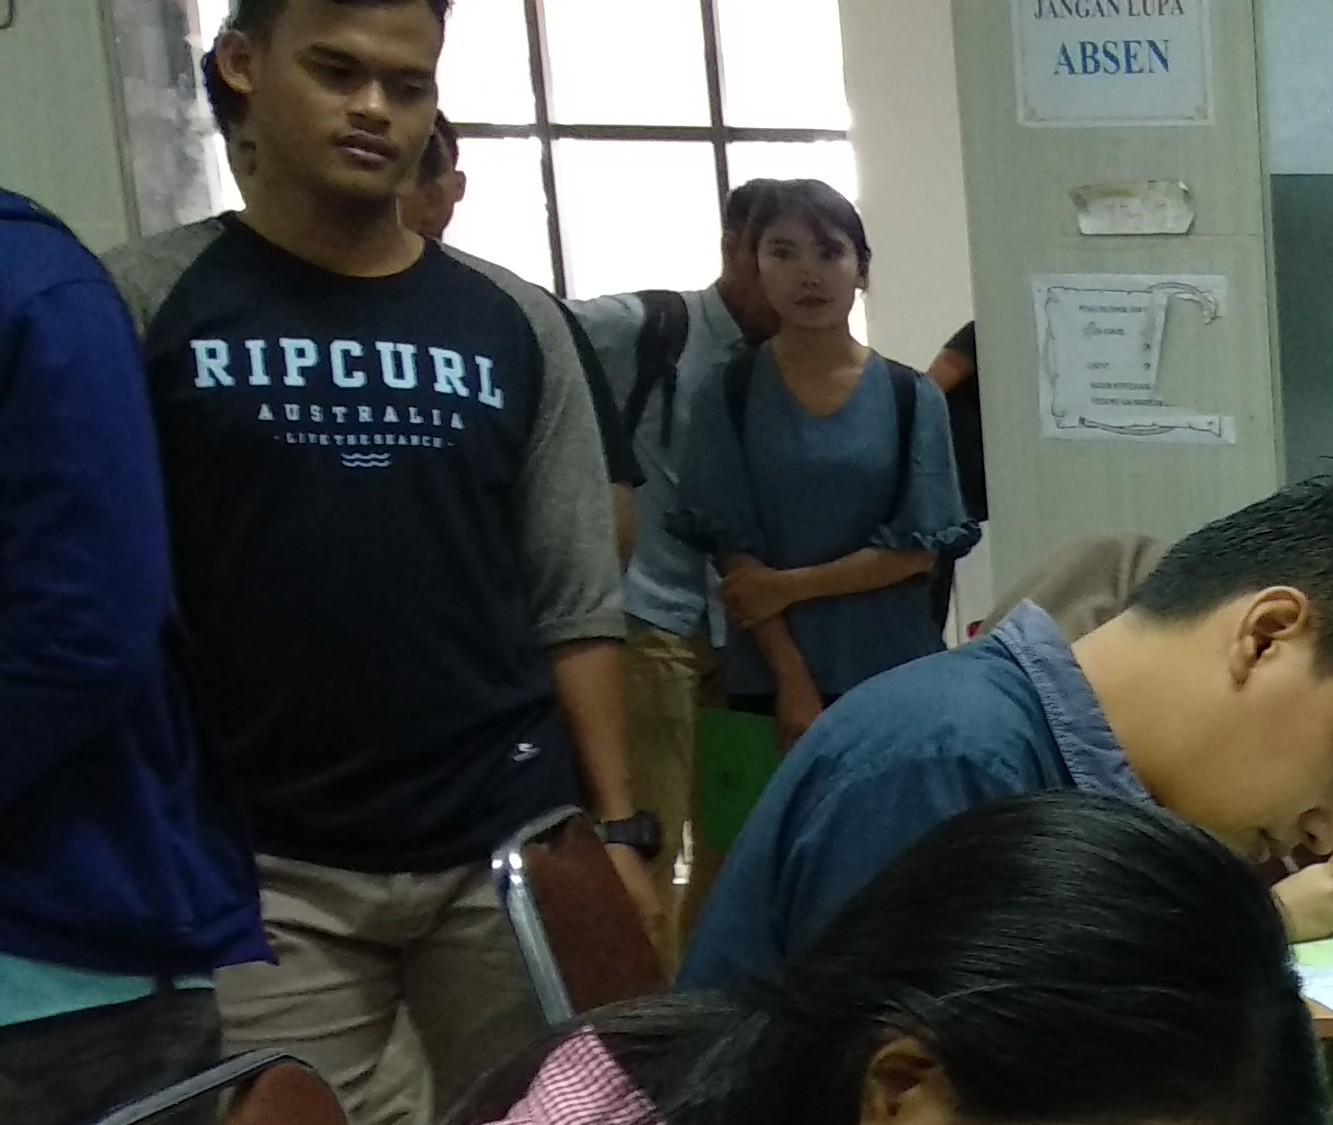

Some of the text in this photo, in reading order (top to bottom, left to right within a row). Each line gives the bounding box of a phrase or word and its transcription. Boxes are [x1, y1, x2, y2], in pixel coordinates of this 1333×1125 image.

[1034, 0, 1184, 19] JANGAN LUPA
[1054, 39, 1170, 75] ABSEN
[190, 337, 504, 409] RIPCURL
[258, 403, 466, 430] AUSTRALIA
